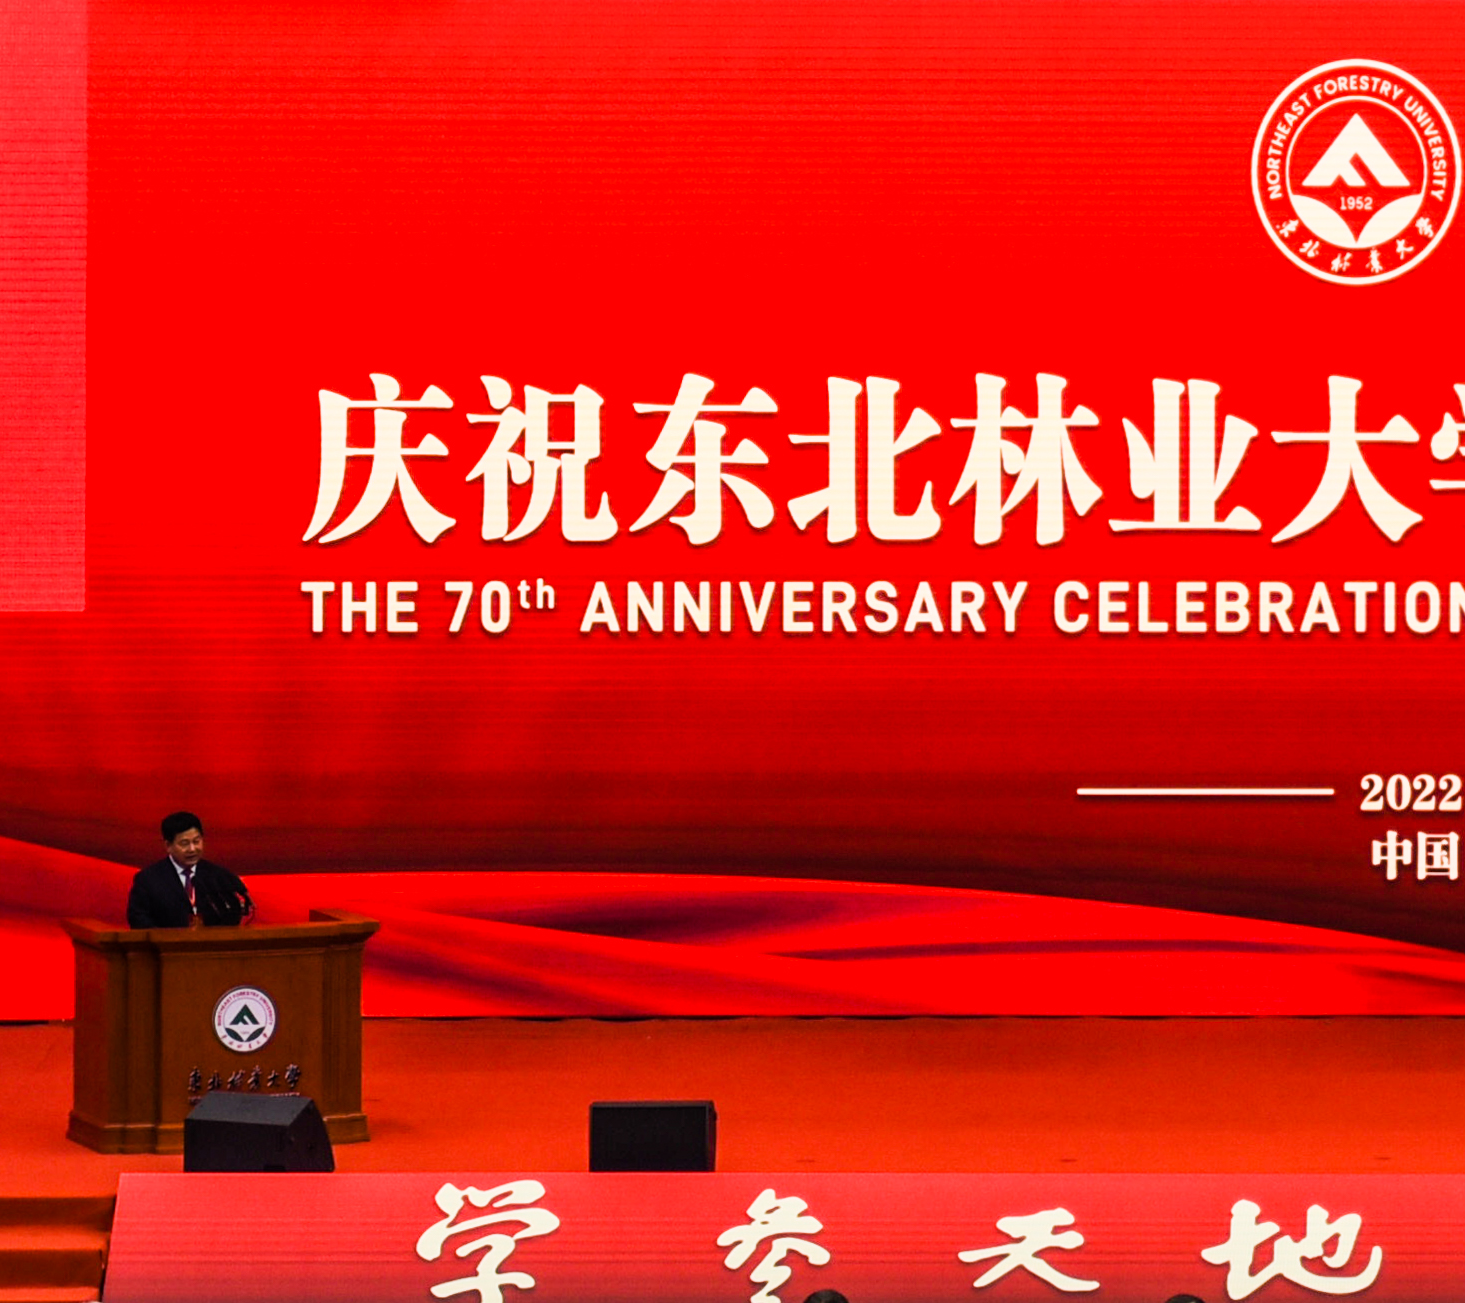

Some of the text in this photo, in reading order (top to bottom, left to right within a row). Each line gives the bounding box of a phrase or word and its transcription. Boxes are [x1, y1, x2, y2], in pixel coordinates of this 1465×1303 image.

[1267, 75, 1447, 201] NORTHEAST FORESTRY UNIVERSITY
[1339, 196, 1373, 210] 1952
[300, 581, 418, 634] THE
[444, 578, 555, 634] 70th
[580, 580, 1028, 634] ANNIVERSARY
